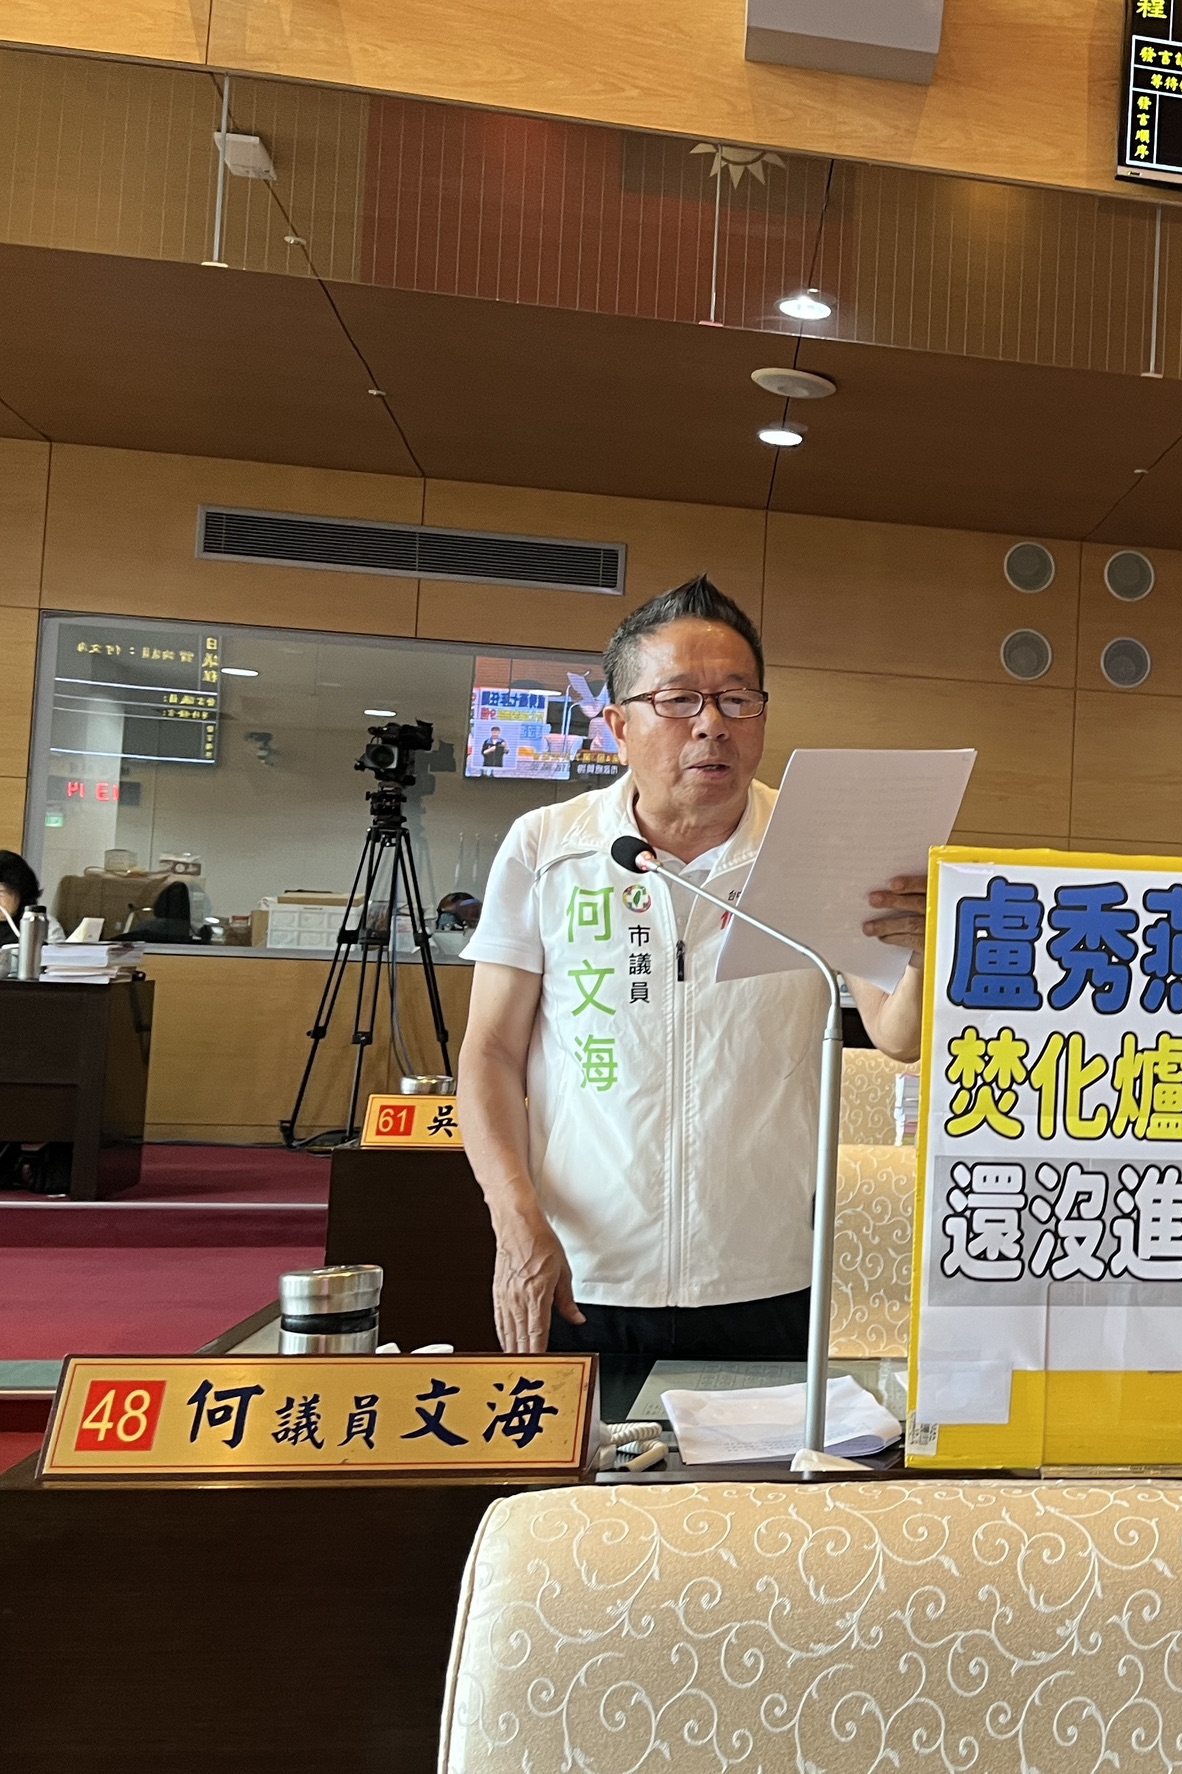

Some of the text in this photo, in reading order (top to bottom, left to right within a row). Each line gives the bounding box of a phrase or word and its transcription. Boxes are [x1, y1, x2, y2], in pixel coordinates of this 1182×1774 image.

[566, 885, 619, 1092] 何文海
[628, 924, 652, 1005] 市議員
[378, 1108, 408, 1133] 61
[80, 1376, 560, 1450] 48 何議員文海
